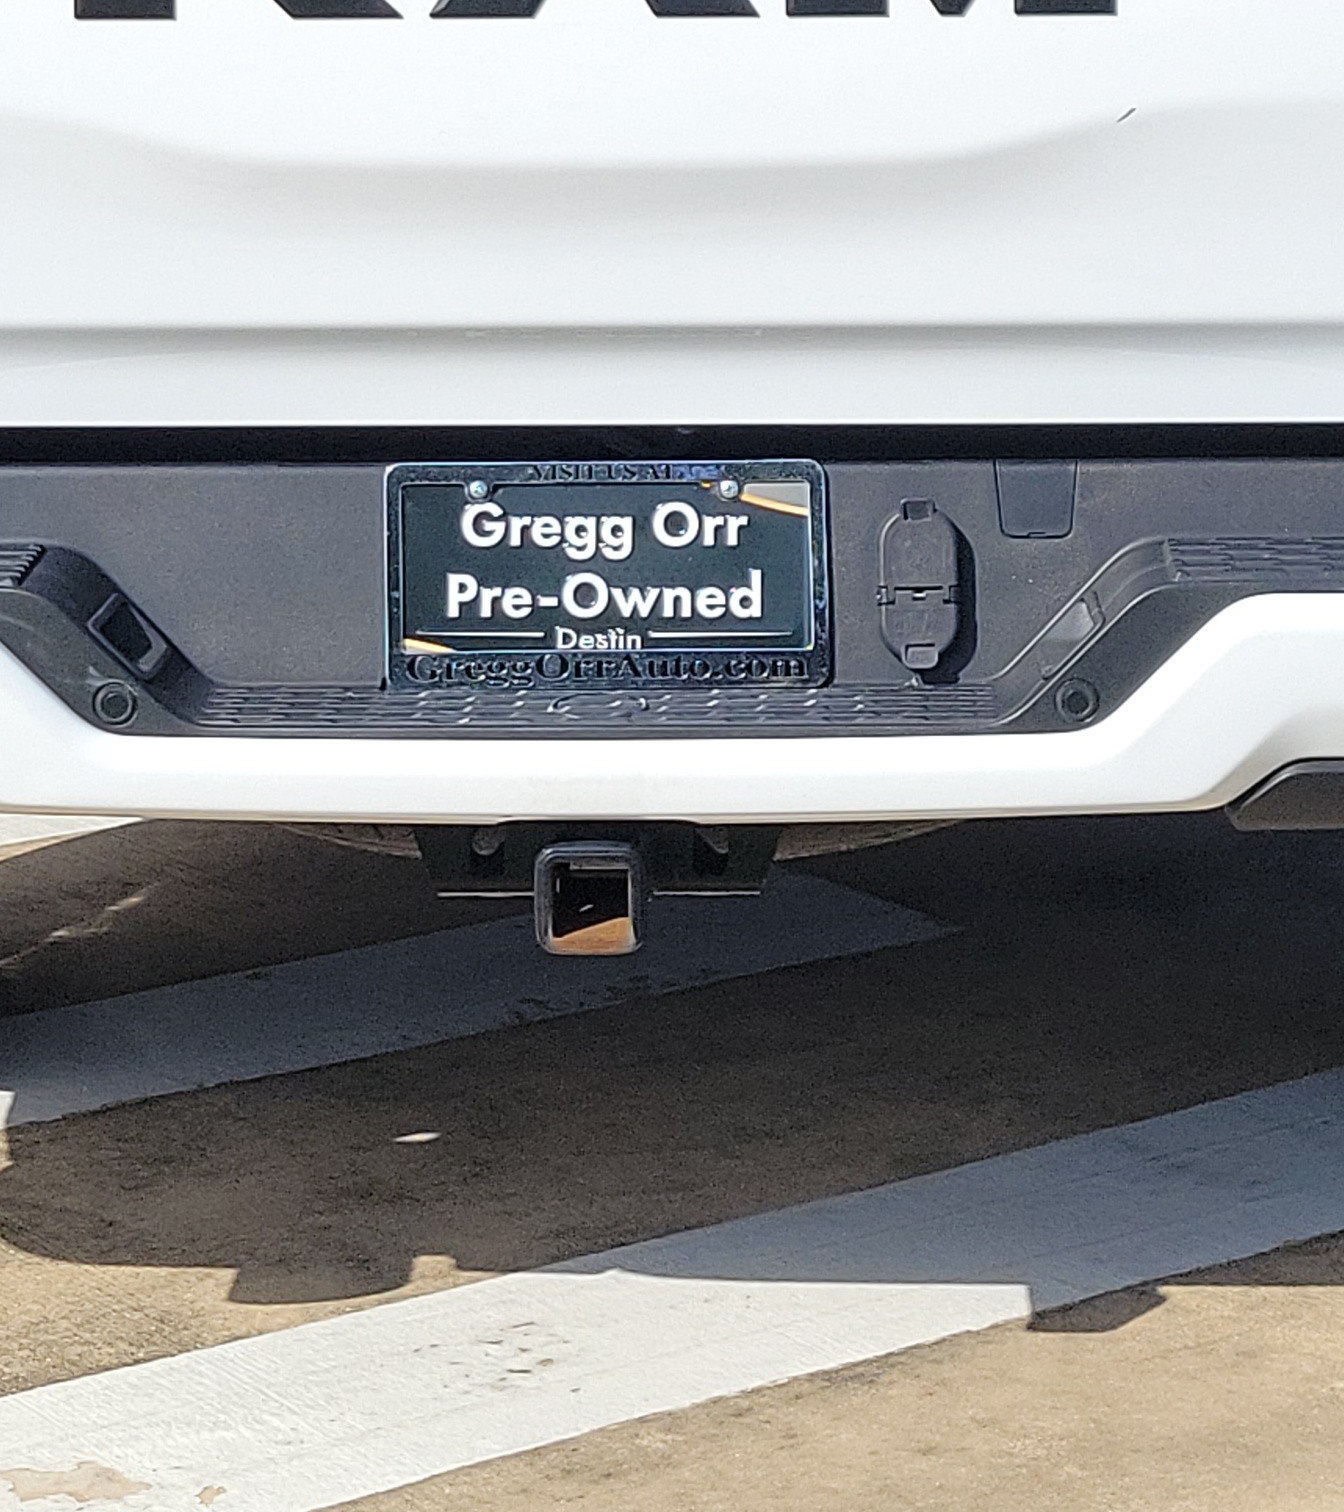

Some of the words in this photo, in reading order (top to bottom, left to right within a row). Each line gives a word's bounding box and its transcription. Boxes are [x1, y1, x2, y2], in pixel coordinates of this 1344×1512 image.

[460, 500, 635, 561] Gregg
[653, 500, 749, 548] Orr
[446, 567, 763, 620] Pre-Owned
[556, 626, 643, 651] Destin
[405, 652, 809, 687] GreggOrrAuto.com
